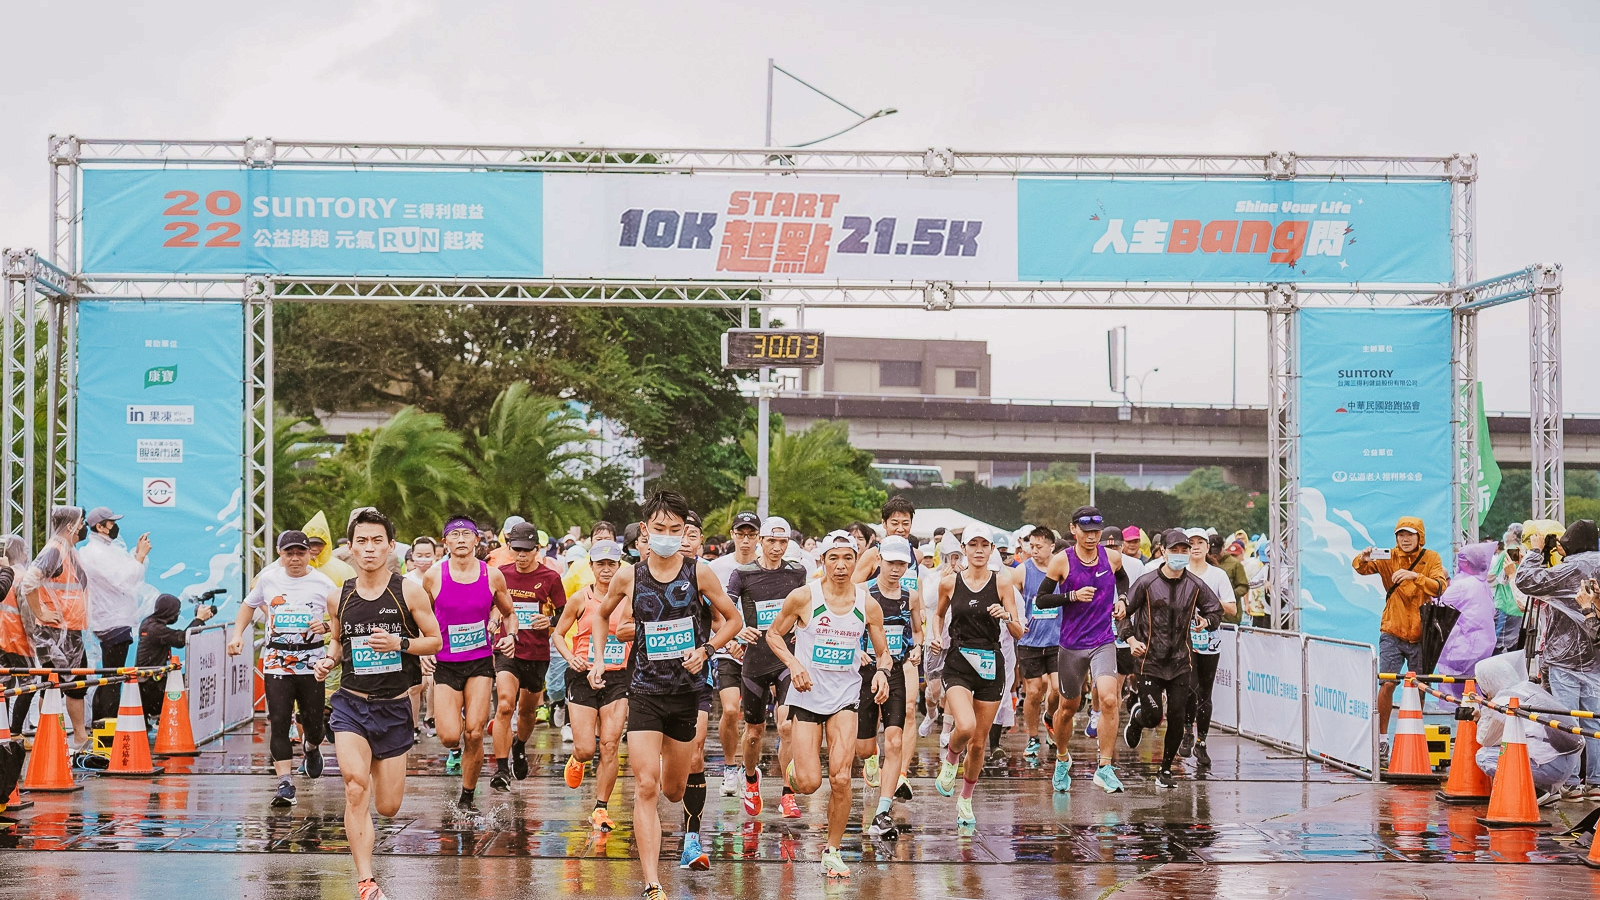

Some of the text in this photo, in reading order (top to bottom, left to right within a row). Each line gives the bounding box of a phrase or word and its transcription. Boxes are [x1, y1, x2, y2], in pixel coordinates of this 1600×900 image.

[162, 190, 242, 216] 20
[253, 196, 484, 221] SUNTORY 三得利健益
[727, 191, 840, 218] START
[1235, 201, 1351, 213] Shine Your Life
[162, 222, 242, 248] 22
[619, 208, 718, 249] 10K
[836, 215, 983, 257] 21.5K
[253, 229, 329, 249] 公益路跑
[716, 219, 833, 274] 起點
[148, 370, 174, 383] 康寶
[1338, 369, 1394, 378] SUNTORY
[130, 407, 144, 421] in
[1347, 401, 1420, 410] 中華民國路跑協會
[276, 615, 309, 624] 02043
[451, 630, 485, 644] 02472
[648, 631, 692, 648] 02468
[815, 648, 853, 660] 02821
[1247, 670, 1280, 696] SUNTORY
[1314, 684, 1348, 714] SUNTORY
